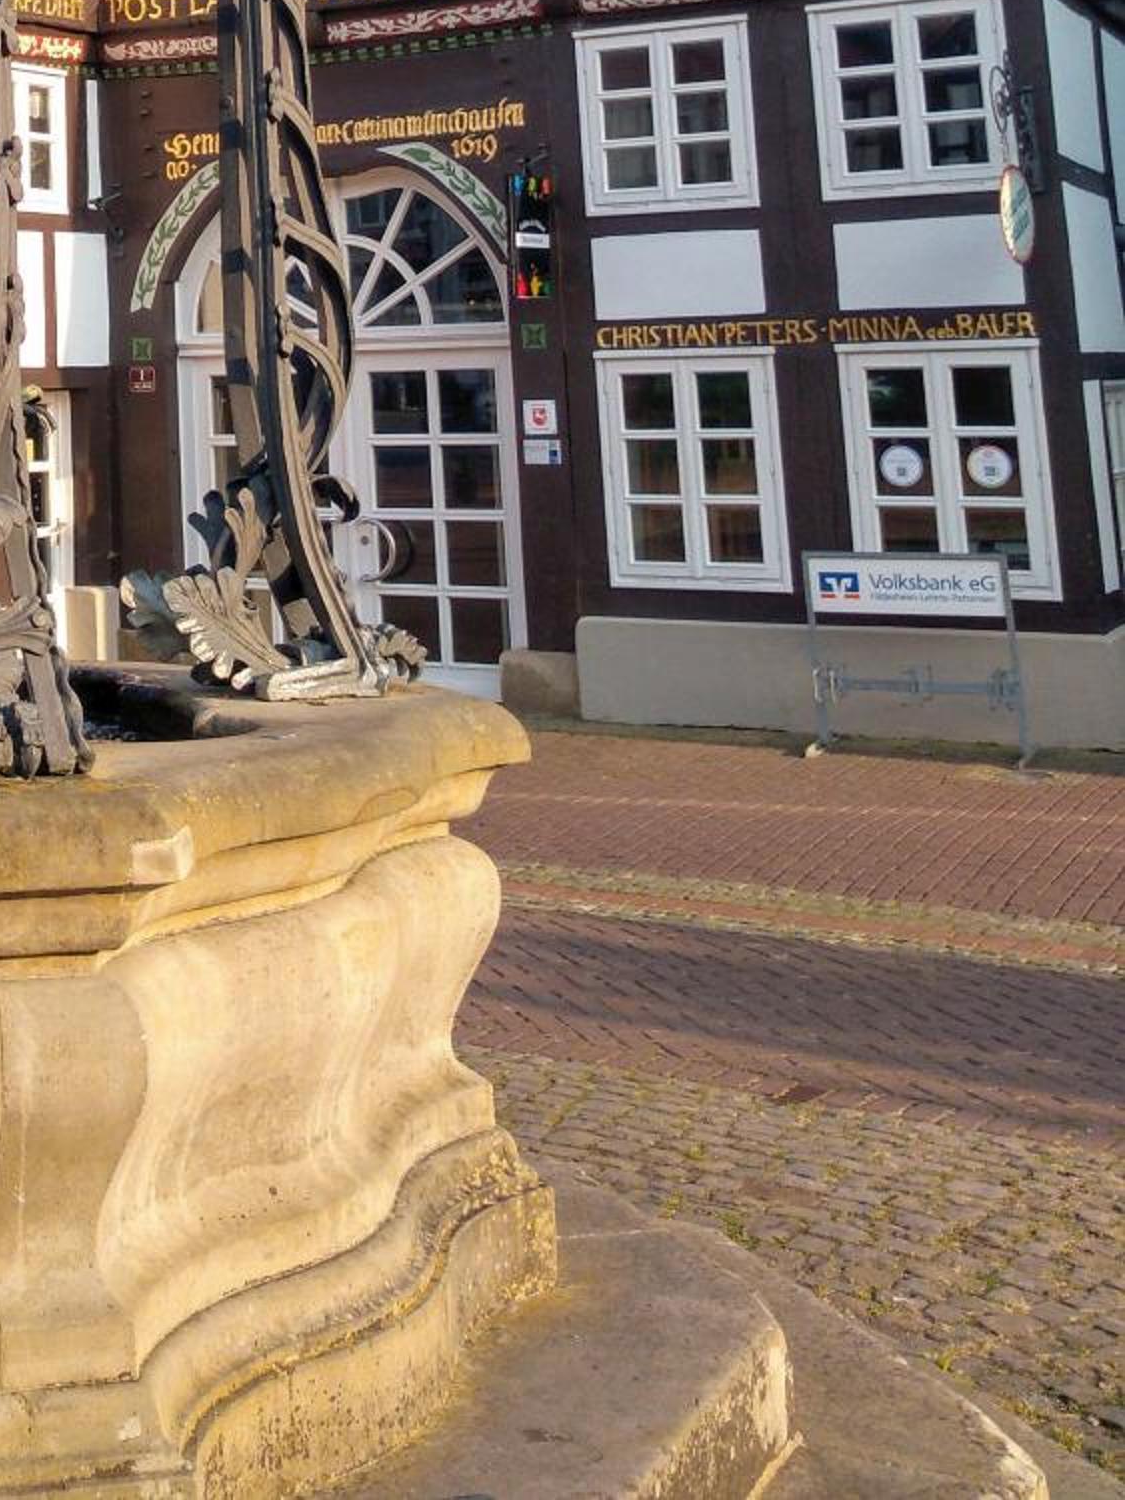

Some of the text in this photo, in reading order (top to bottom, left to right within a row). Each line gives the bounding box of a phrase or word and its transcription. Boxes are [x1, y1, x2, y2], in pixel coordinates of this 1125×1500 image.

[451, 134, 498, 163] 1619
[595, 323, 717, 349] CHRISTIAN
[718, 318, 818, 345] PETERS
[828, 316, 925, 342] MINNA
[868, 572, 996, 592] Volksbank eG
